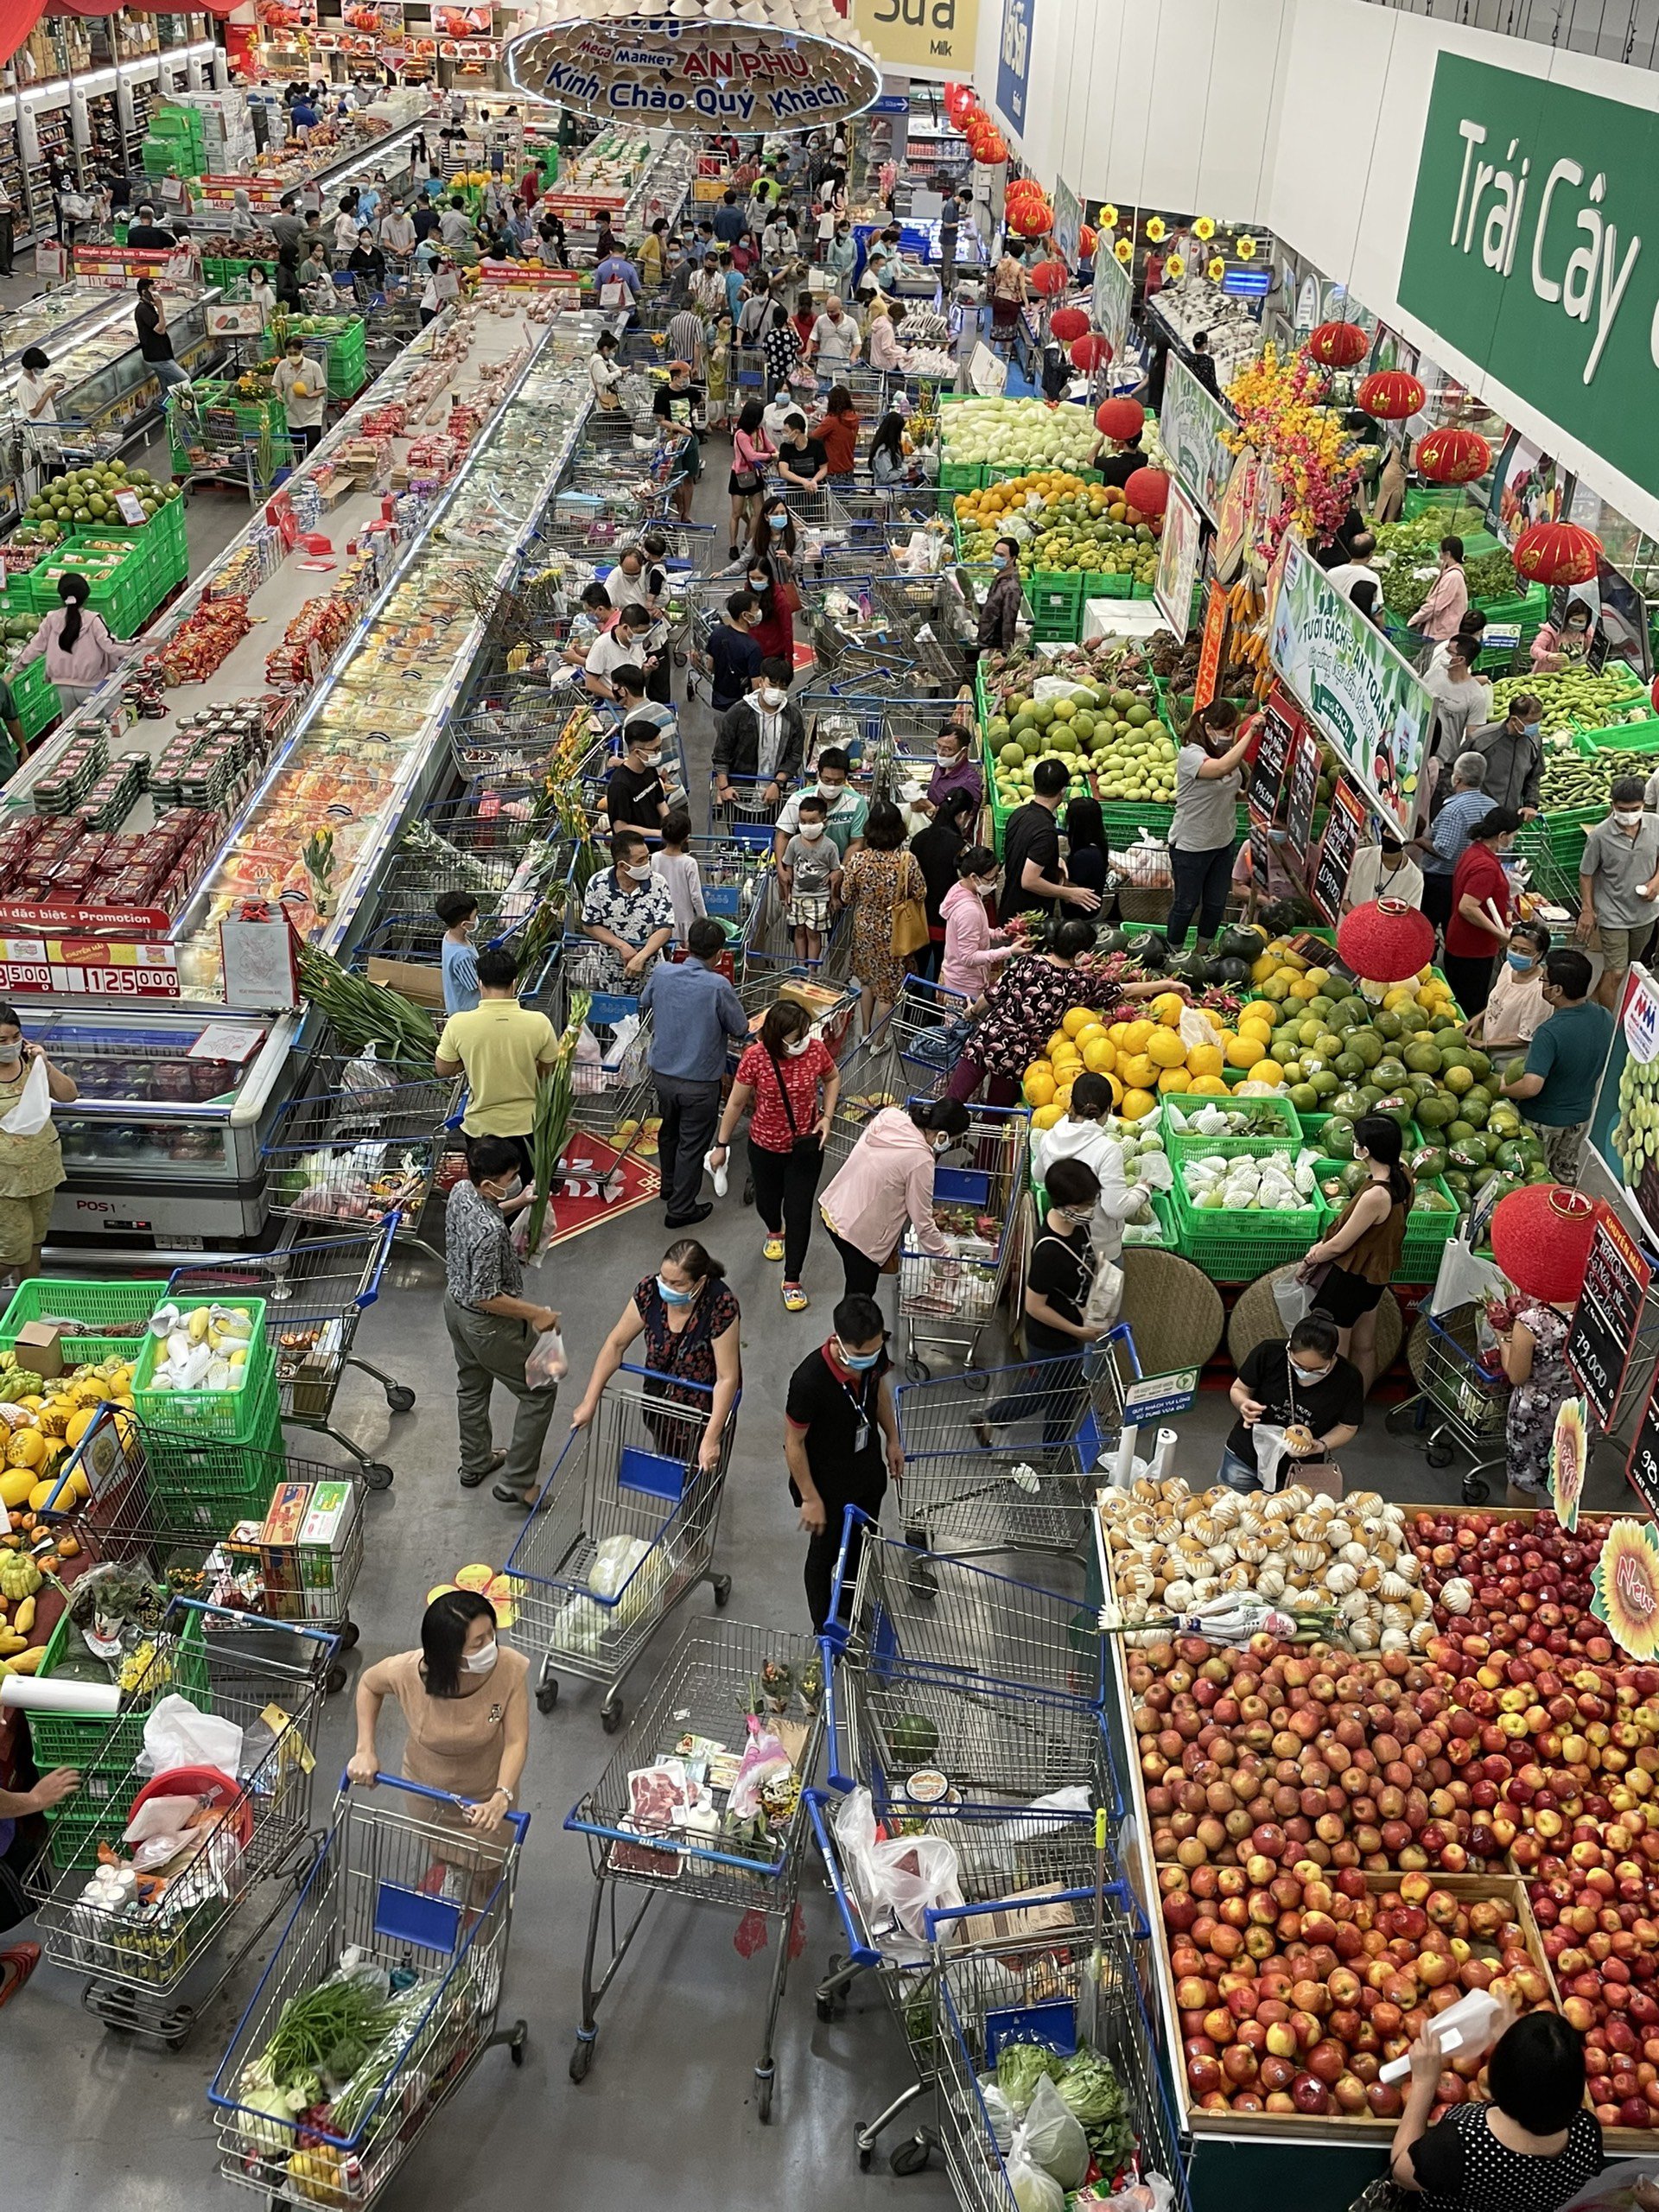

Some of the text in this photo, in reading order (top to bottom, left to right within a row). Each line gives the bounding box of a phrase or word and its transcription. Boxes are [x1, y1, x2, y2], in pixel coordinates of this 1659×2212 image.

[683, 51, 733, 78] AN
[930, 40, 952, 56] Milk
[547, 61, 847, 119] Kính Chào Quý Khách
[1450, 118, 1642, 385] Trái Cây
[11, 908, 35, 919] đặc
[41, 910, 67, 921] biệt
[79, 911, 150, 924] Promotion
[1618, 1555, 1656, 1614] New
